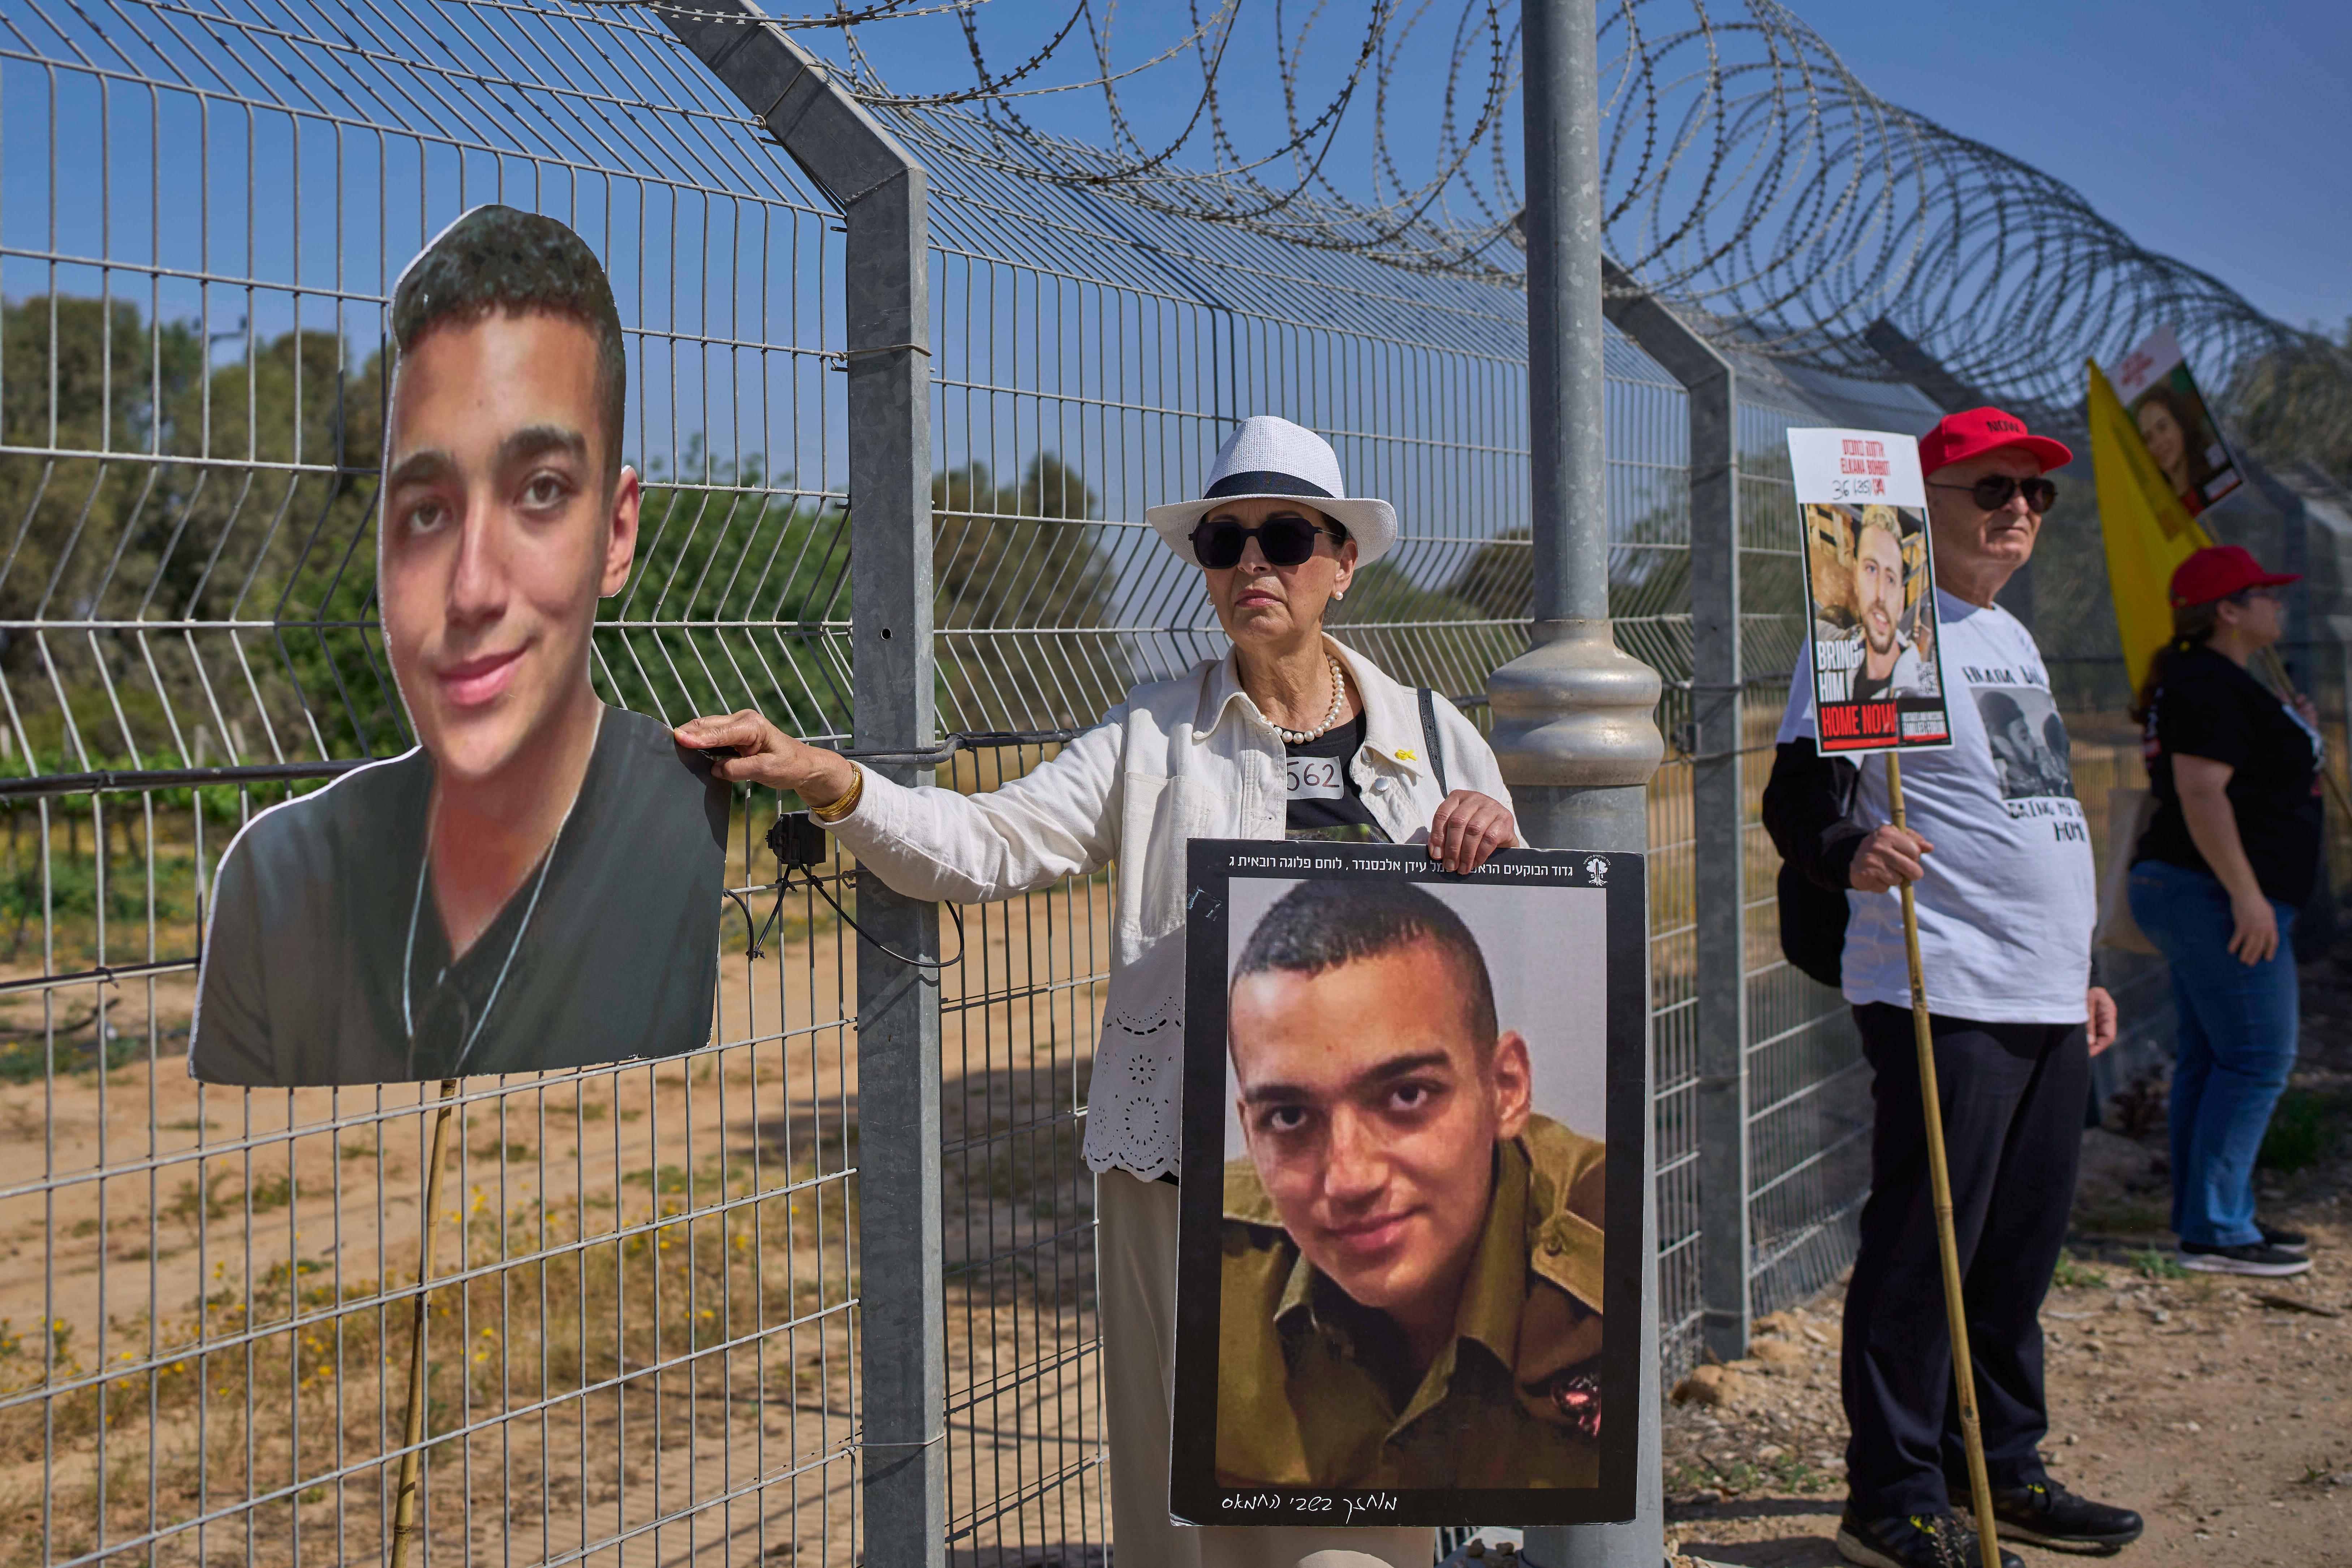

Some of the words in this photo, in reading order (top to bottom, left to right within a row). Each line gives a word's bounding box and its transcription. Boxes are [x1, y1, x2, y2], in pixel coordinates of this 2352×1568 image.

[1987, 420, 2020, 432] NOW
[1817, 639, 1860, 671] BRING
[1818, 671, 1846, 702] HIM
[1821, 705, 1860, 737] HOME
[1861, 700, 1896, 735] NOW
[1287, 761, 1339, 791] 562
[1229, 856, 1234, 866] ג
[1237, 857, 1276, 867] רובאית
[1280, 856, 1311, 868] פלוגה
[1315, 857, 1342, 869] לוחם
[1352, 858, 1400, 871] אלכסנדר
[1405, 861, 1426, 874] עידן
[1430, 860, 1452, 873] מל
[1504, 865, 1548, 877] הבוקעים
[1551, 866, 1573, 876] גדוד
[1222, 1494, 1280, 1510] החמאס
[1290, 1496, 1332, 1511] בשבי
